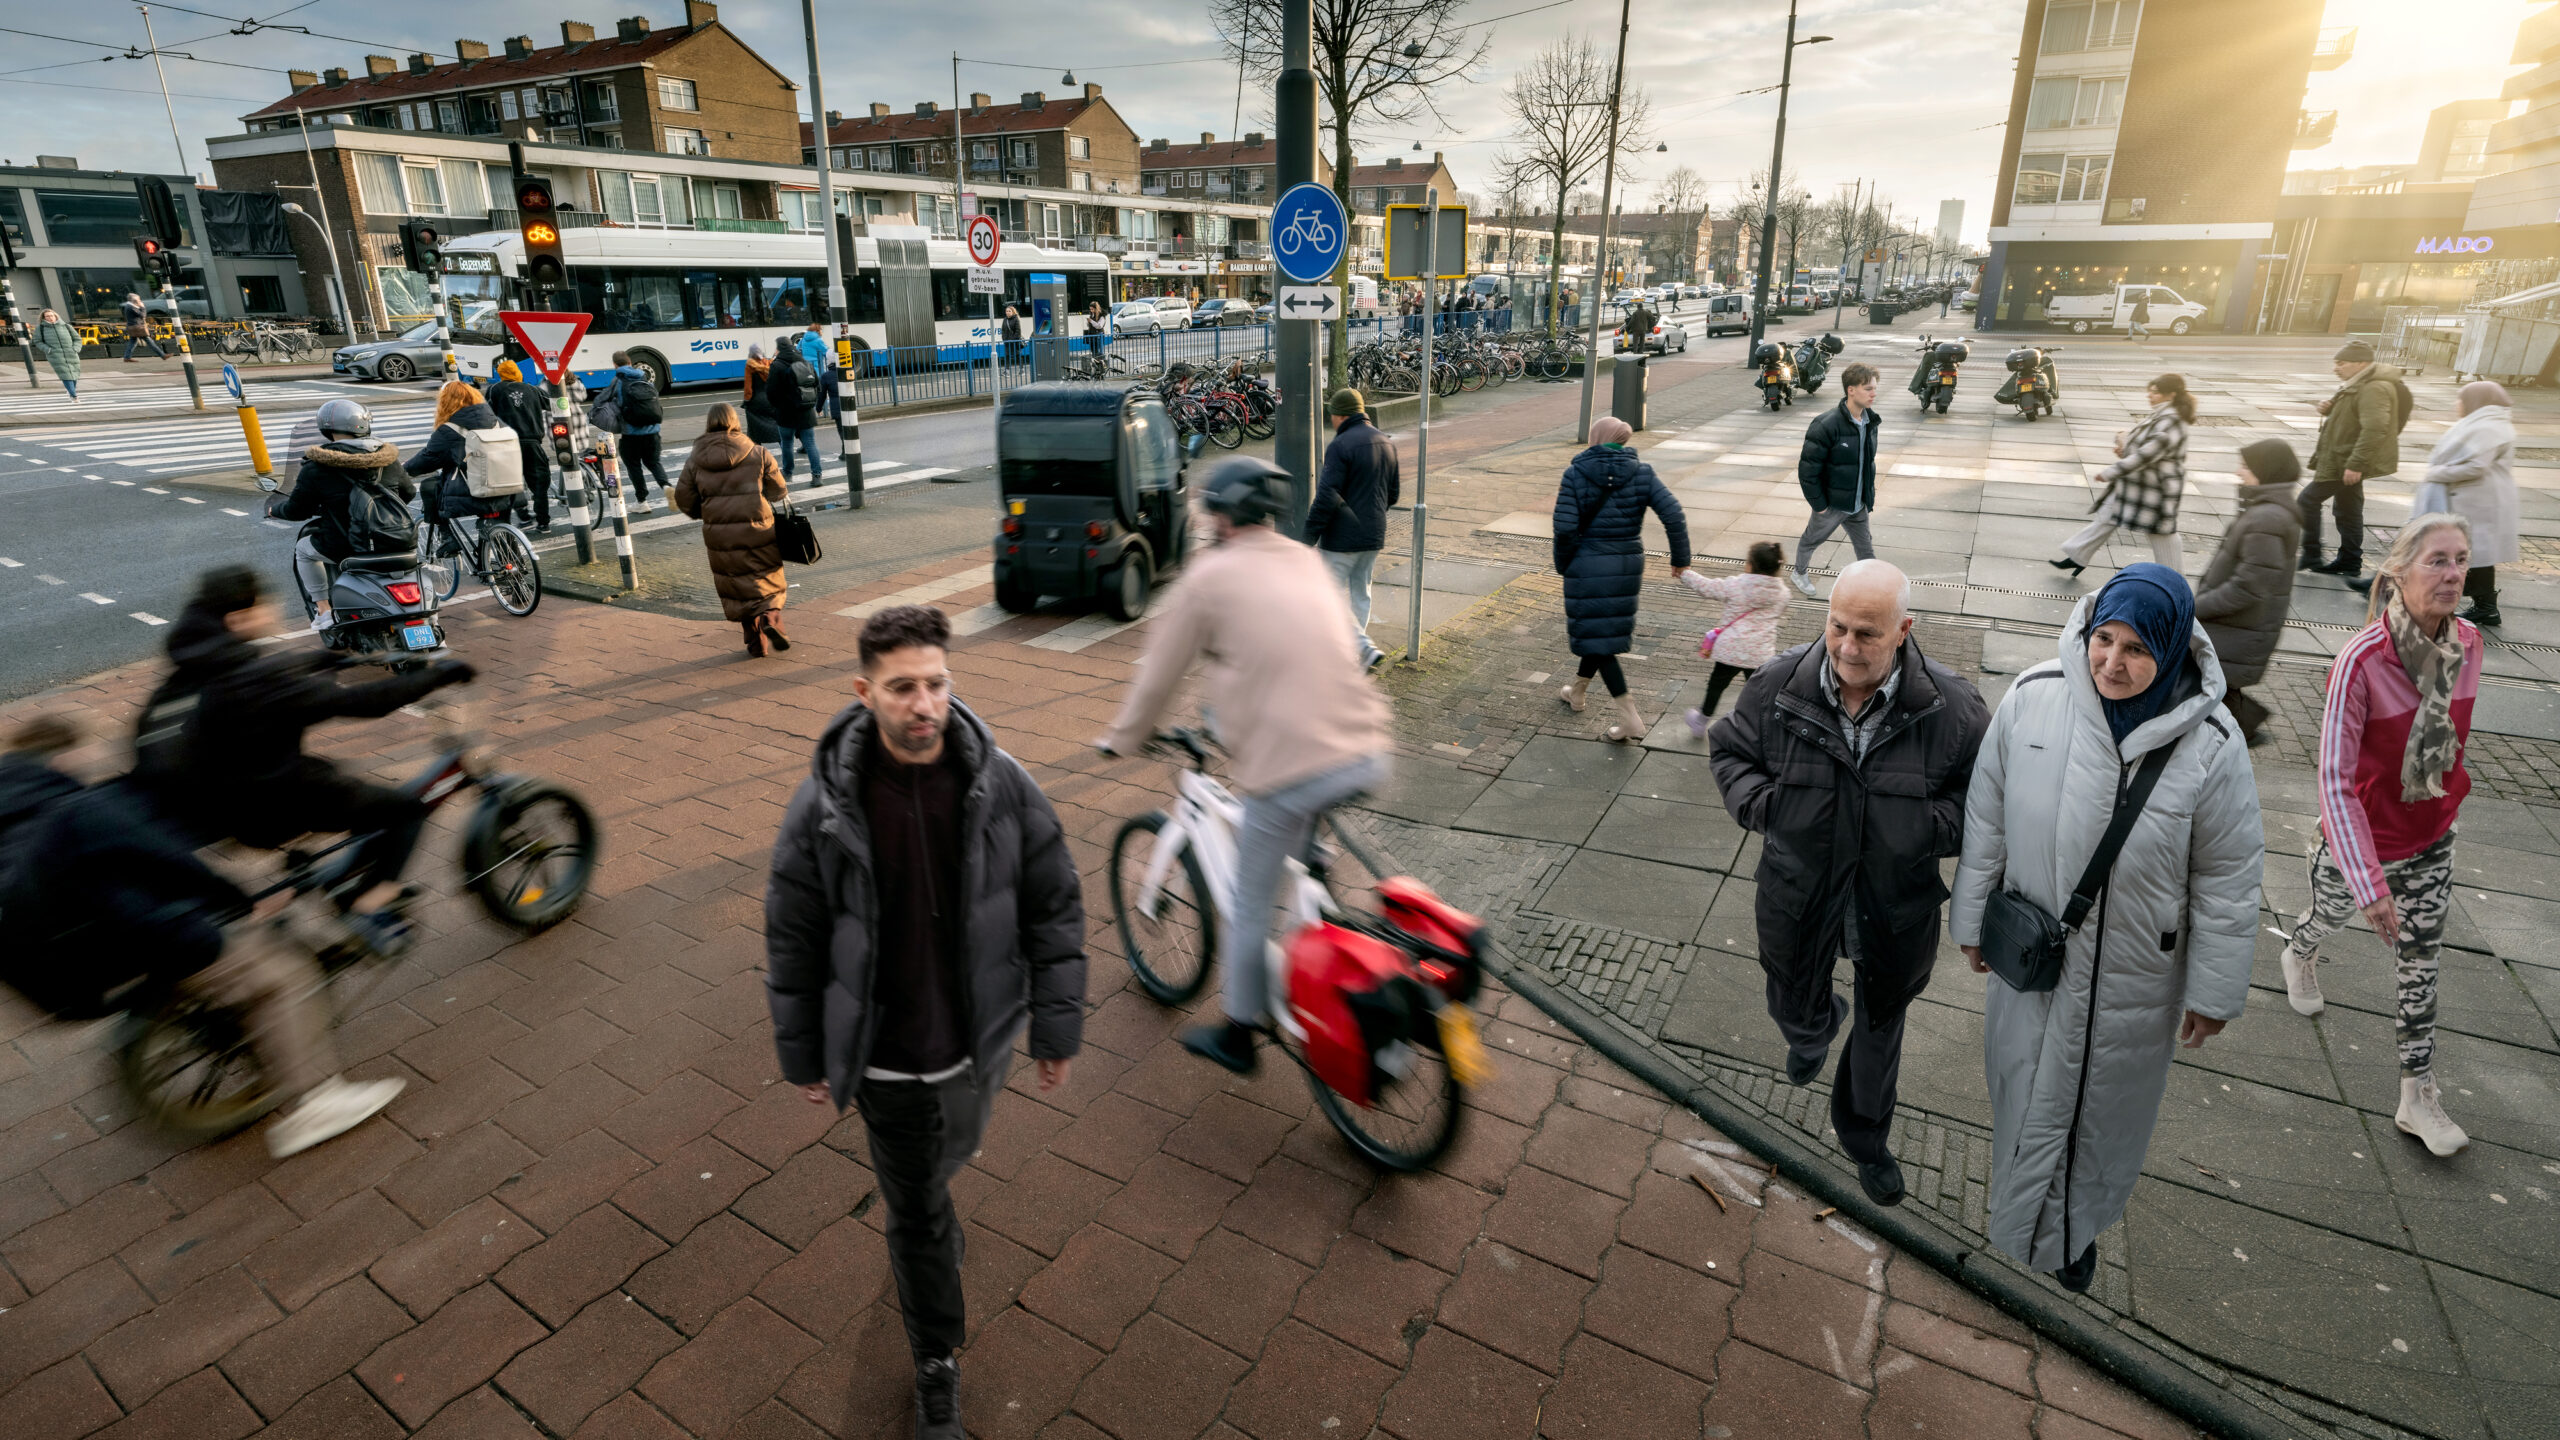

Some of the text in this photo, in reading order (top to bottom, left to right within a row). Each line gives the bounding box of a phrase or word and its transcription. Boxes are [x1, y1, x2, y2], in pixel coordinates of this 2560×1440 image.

[974, 231, 993, 250] 30
[2415, 236, 2494, 254] MADO
[444, 256, 492, 271] 21 Geuzenveld
[971, 276, 999, 284] gebruikers
[605, 282, 615, 293] 21
[973, 284, 997, 292] OV-baan
[714, 340, 739, 351] GVB
